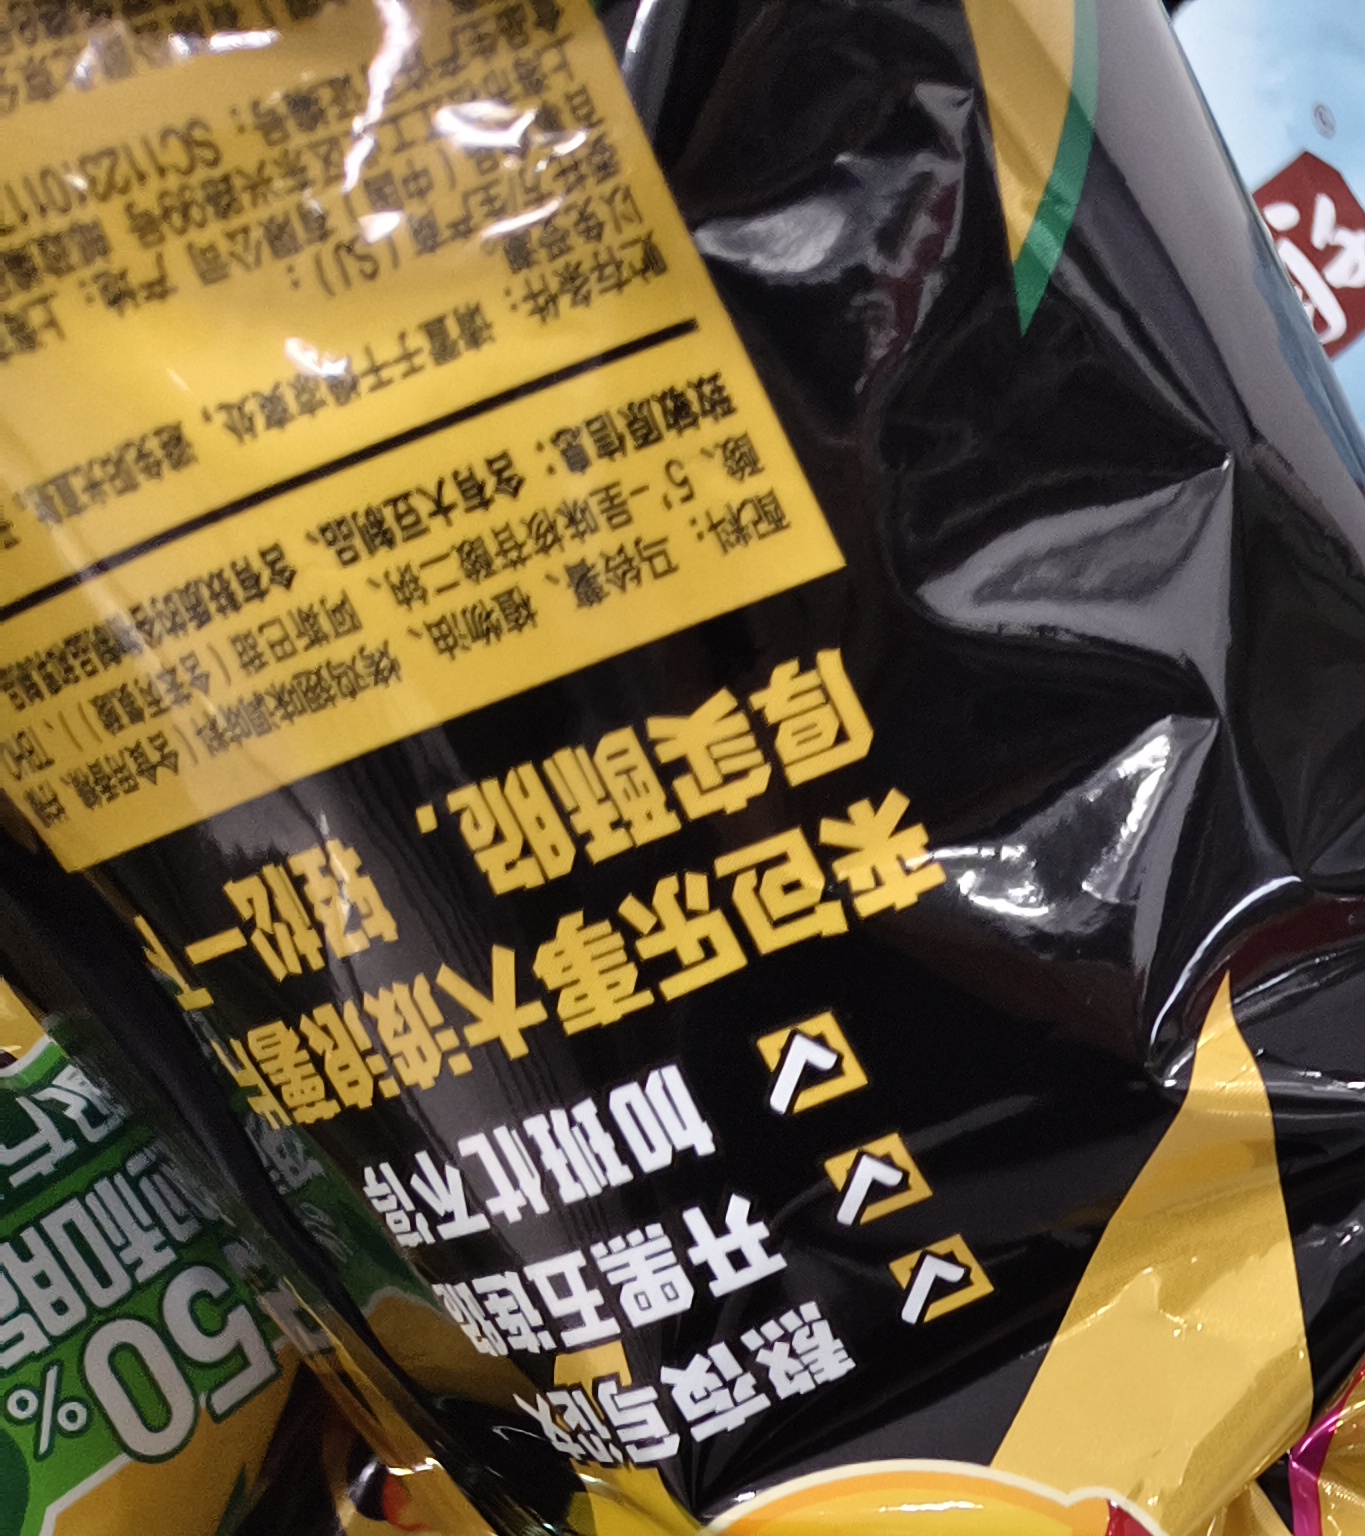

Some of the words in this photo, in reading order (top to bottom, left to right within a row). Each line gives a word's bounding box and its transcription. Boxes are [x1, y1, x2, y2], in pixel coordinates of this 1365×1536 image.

[211, 787, 948, 1130] 来包乐事大波浪薯片
[363, 1064, 716, 1248] 加班忙不停
[6, 1264, 280, 1459] 50%
[511, 1301, 858, 1466] 熬夜写论文
